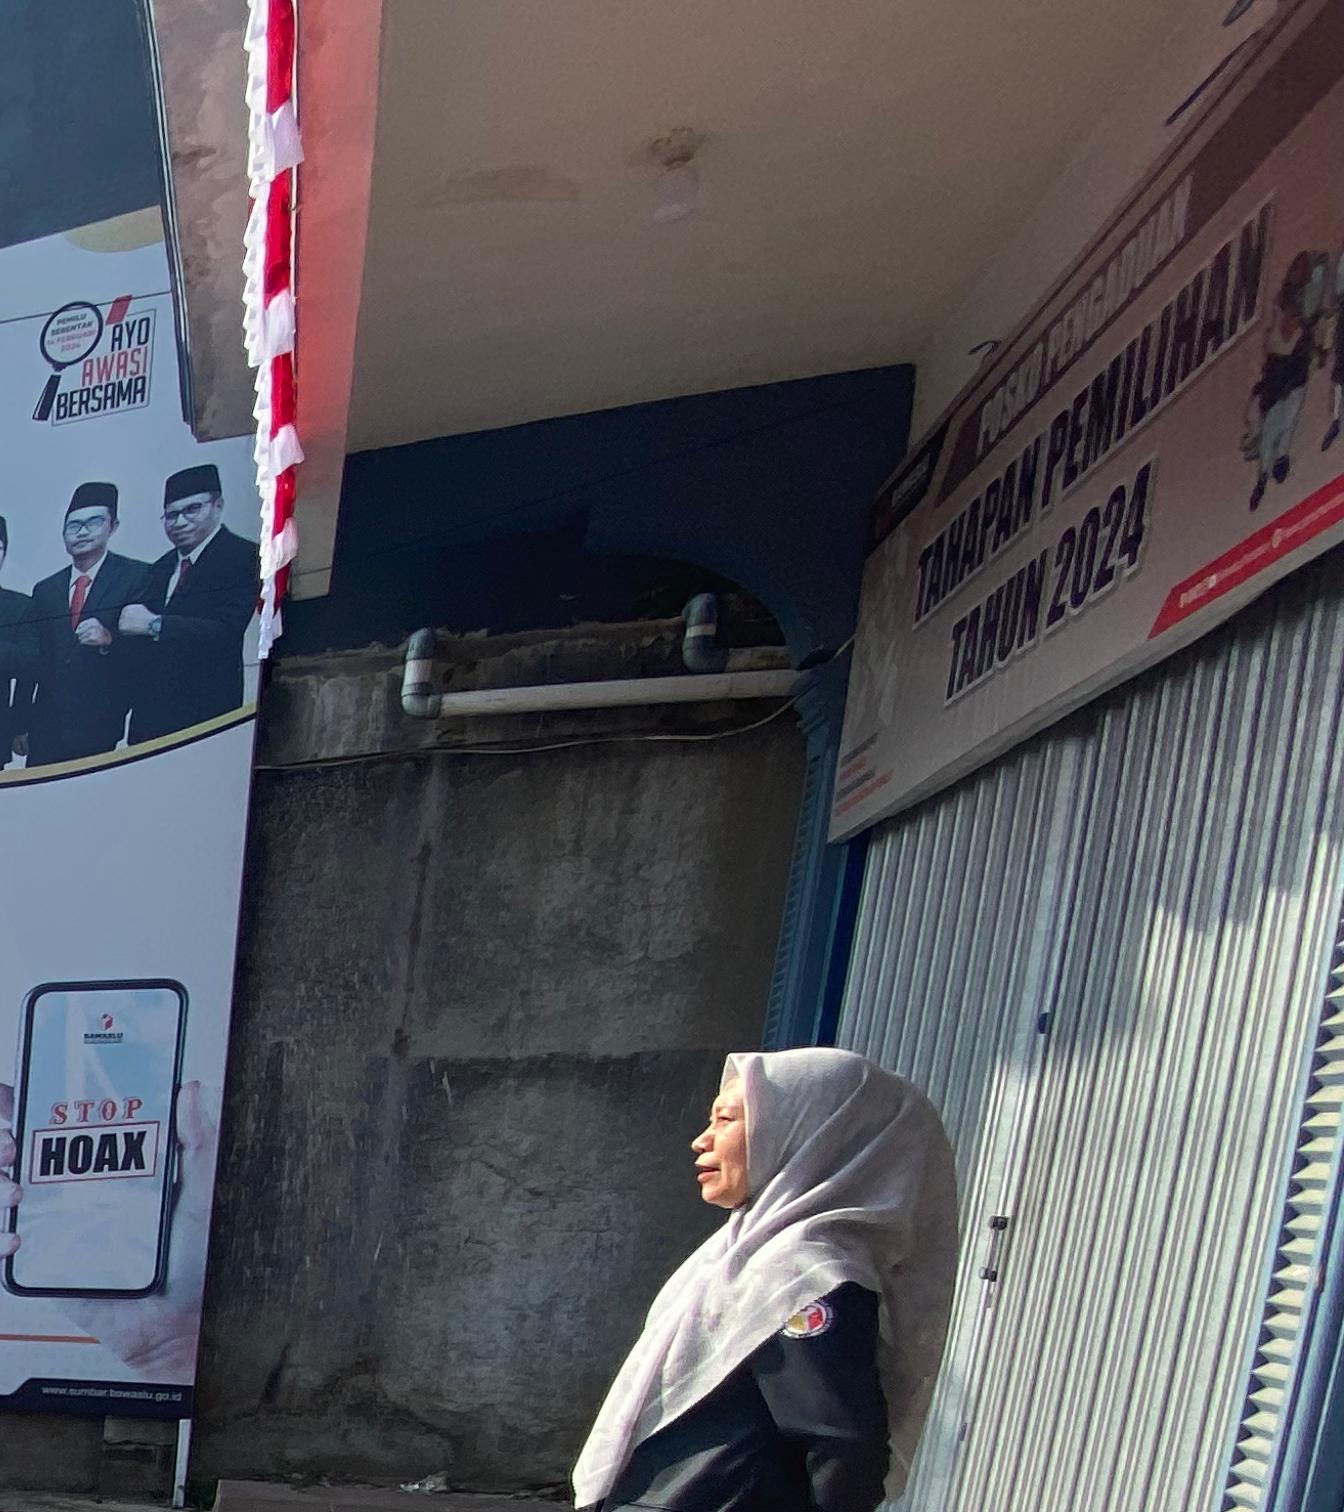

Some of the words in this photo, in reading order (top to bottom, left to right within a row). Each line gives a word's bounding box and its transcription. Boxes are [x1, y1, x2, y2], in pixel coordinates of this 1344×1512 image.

[111, 317, 150, 352] AYO
[82, 347, 148, 387] AWASI
[56, 376, 147, 420] BERSAMA
[915, 432, 1043, 625] TAHAPAN
[1043, 203, 1272, 511] PEMILIHAN
[946, 549, 1048, 702] TAHUN
[1047, 461, 1154, 629] 2024
[49, 1096, 143, 1125] STOP
[40, 1130, 147, 1176] HOAX
